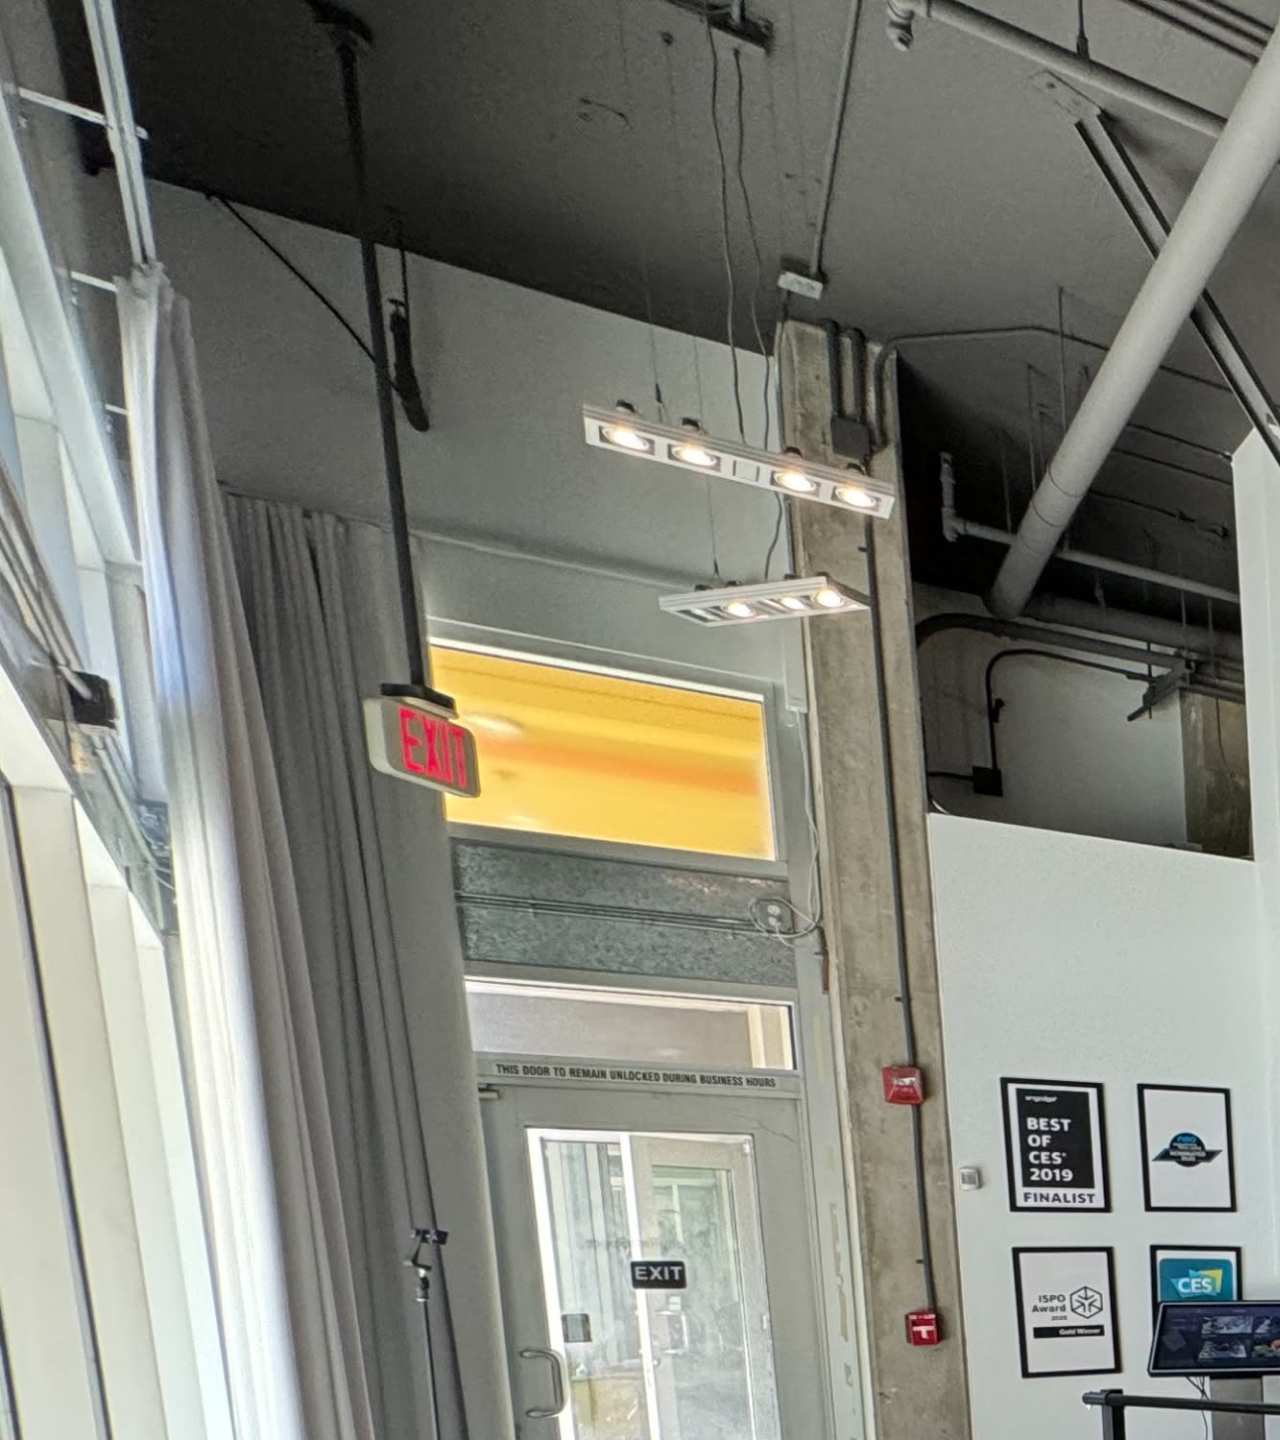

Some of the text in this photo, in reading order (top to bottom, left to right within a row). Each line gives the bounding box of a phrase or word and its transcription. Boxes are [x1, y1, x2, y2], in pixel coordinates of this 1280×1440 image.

[397, 706, 466, 789] EXIT
[496, 1064, 776, 1087] THIS DOOR TO REMAIN UNLOCKED DURING BUSINESS HOURS
[1026, 1117, 1071, 1132] BEST
[1027, 1134, 1052, 1147] OF
[1029, 1168, 1073, 1182] 2019
[1023, 1192, 1096, 1204] FINALIST
[634, 1266, 683, 1280] EXIT
[1178, 1277, 1213, 1293] CES
[1038, 1294, 1066, 1303] ISPO
[1032, 1304, 1066, 1313] Award
